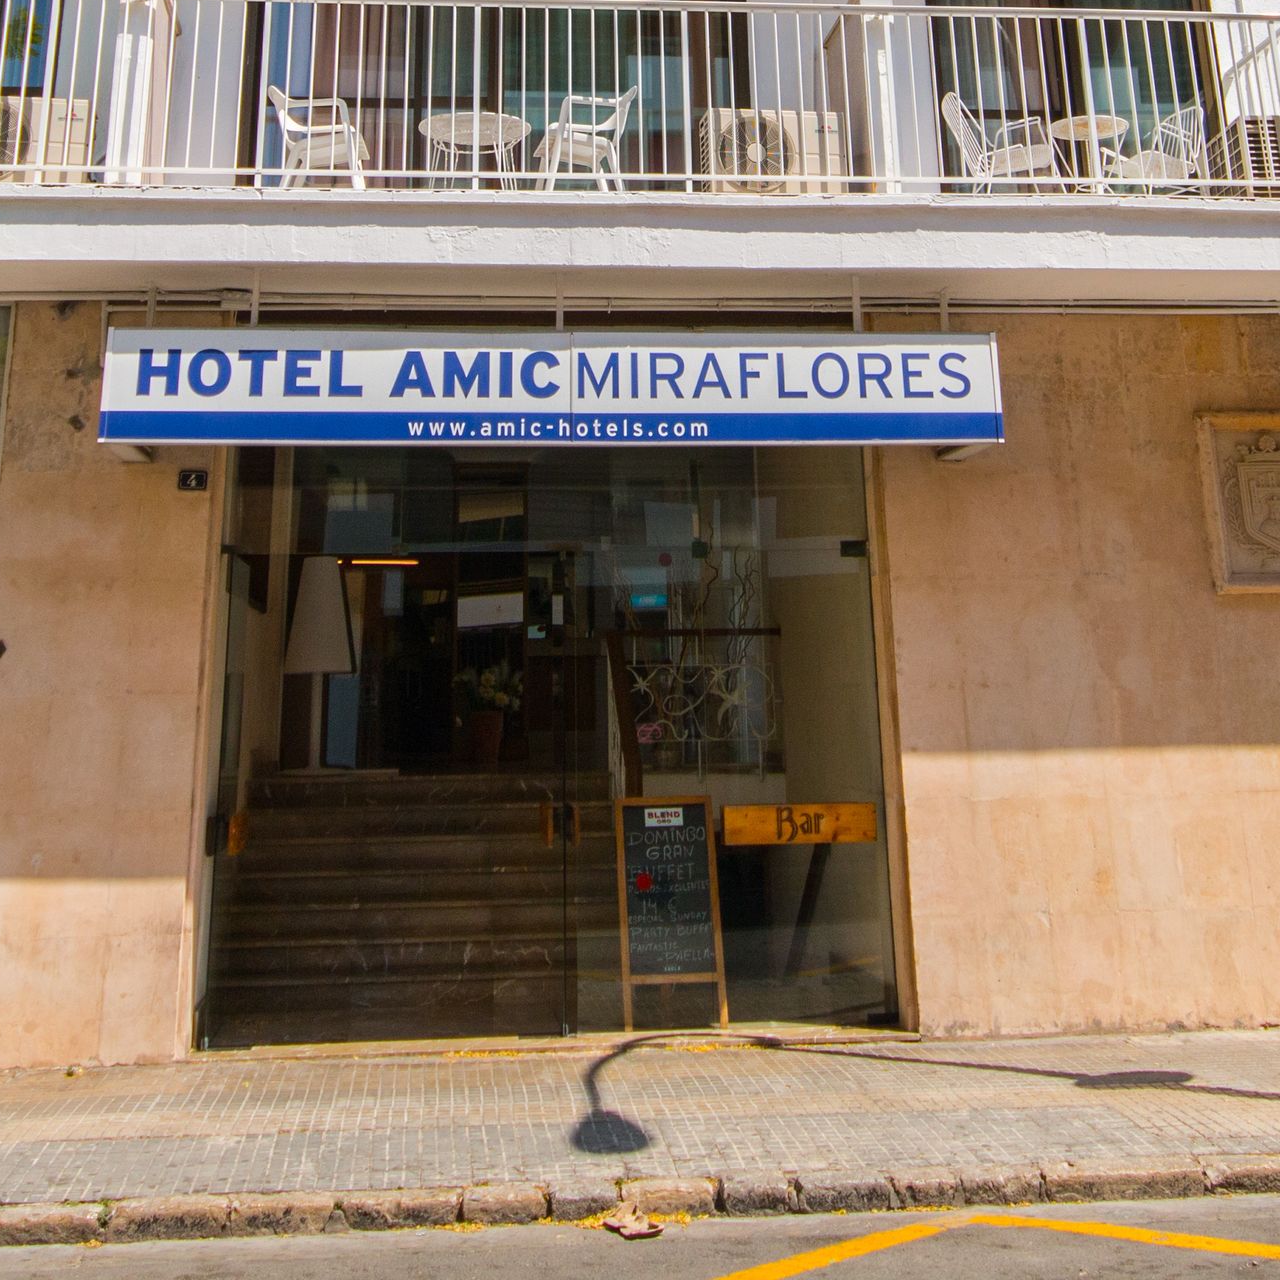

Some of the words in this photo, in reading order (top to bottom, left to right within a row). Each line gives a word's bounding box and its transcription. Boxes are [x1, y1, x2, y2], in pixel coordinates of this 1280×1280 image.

[136, 348, 363, 397] HOTEL
[389, 350, 561, 399] AMIC
[578, 352, 972, 400] MIRAFLORES
[408, 417, 709, 438] www.amic-hotels.com
[186, 474, 196, 487] 4
[647, 811, 680, 819] BLEND
[776, 806, 824, 842] Bar
[628, 826, 705, 846] DOMINGO
[646, 845, 694, 860] GRAN
